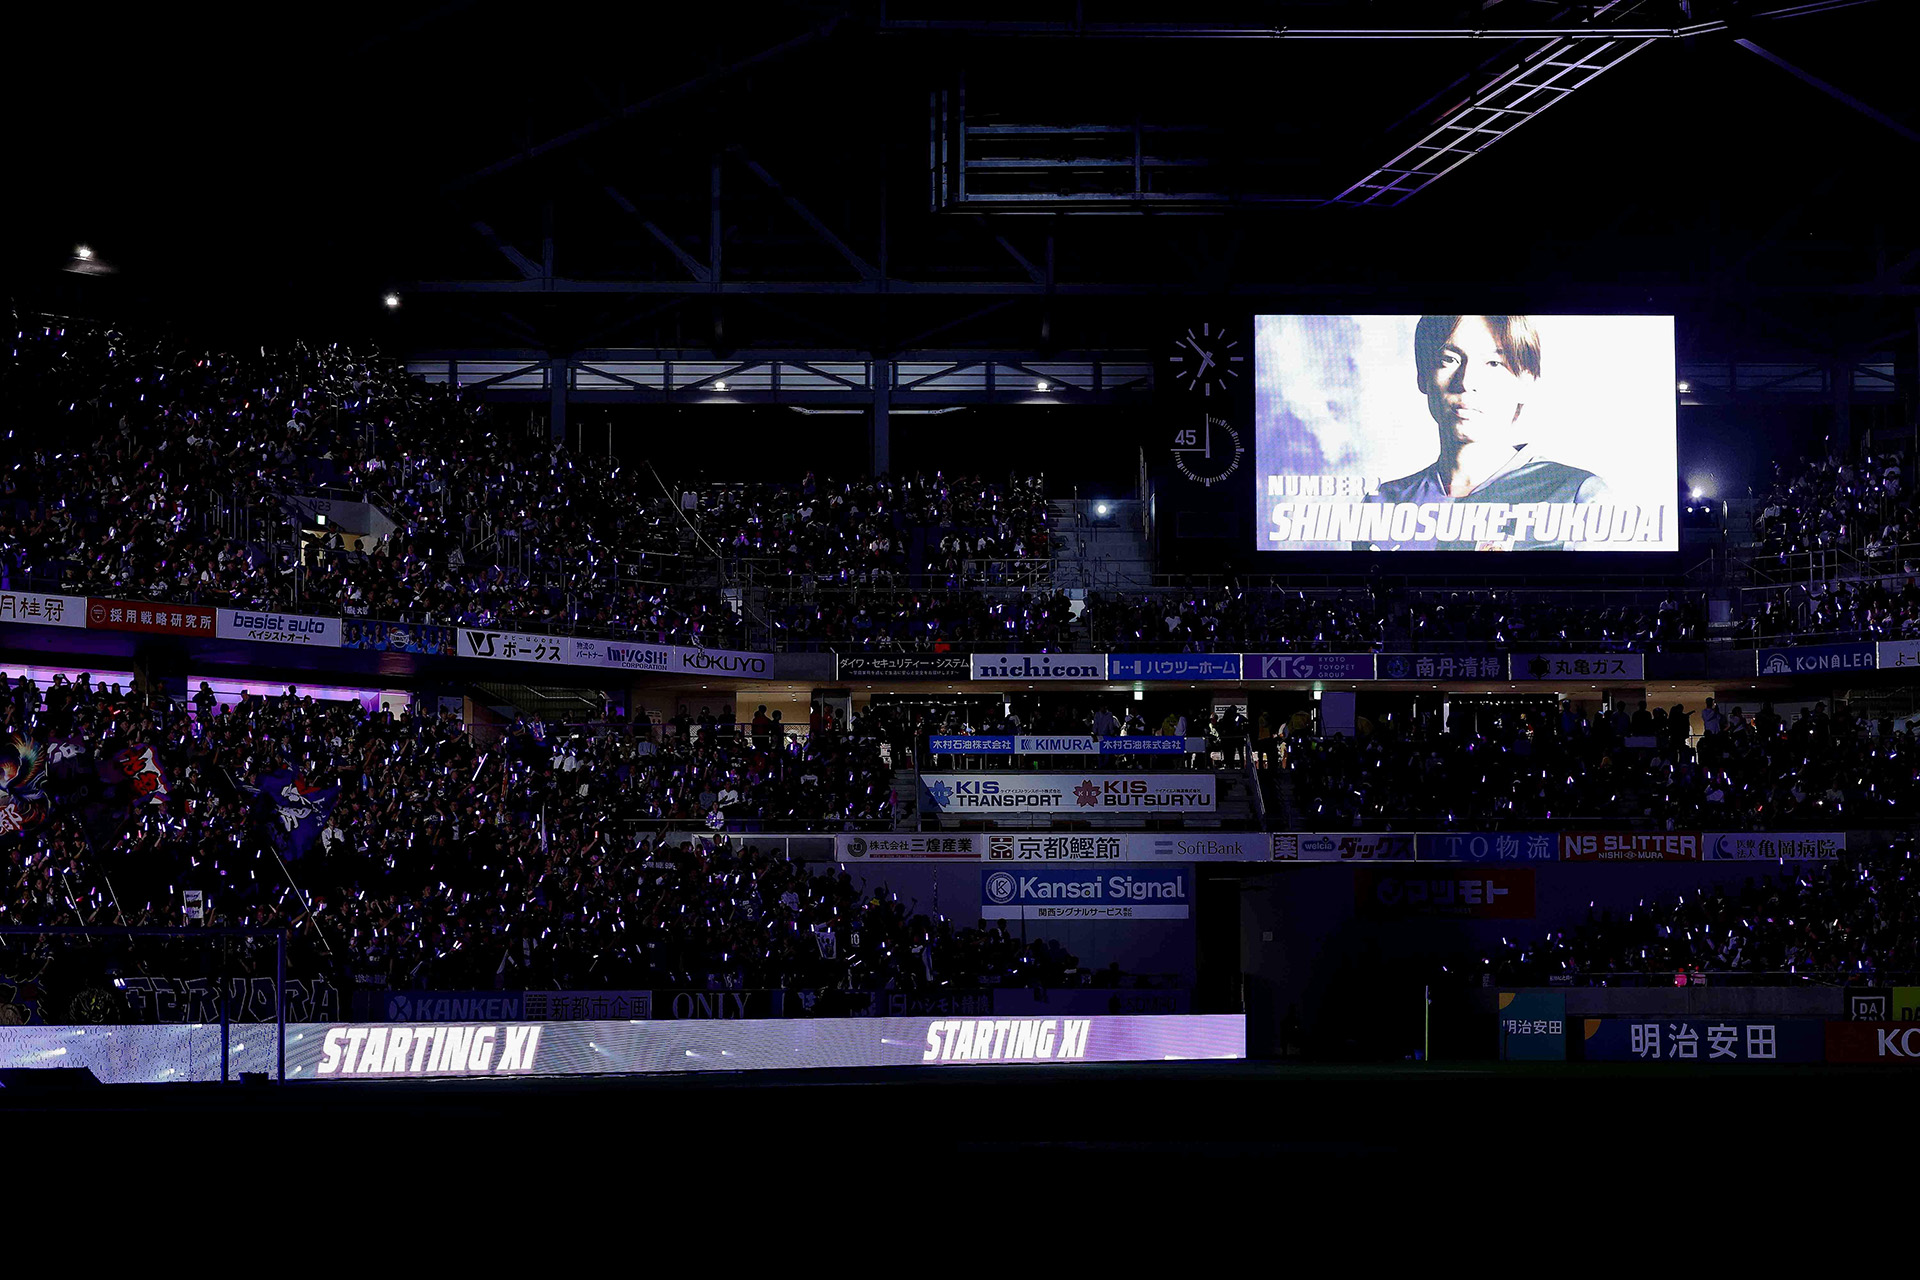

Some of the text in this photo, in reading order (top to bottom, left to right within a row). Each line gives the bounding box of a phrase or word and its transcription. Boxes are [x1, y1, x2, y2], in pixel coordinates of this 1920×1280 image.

[1174, 429, 1197, 446] 45
[1268, 475, 1365, 496] NUMBER
[309, 499, 331, 512] N23
[1269, 502, 1665, 542] SHINNOSUKE FUKUDA
[0, 594, 64, 622] 月桂冠
[109, 607, 212, 630] 採用戦略研究所
[233, 611, 325, 634] basist auto
[247, 629, 311, 642] ベイシストオート
[503, 642, 561, 662] ボークス
[576, 650, 604, 660] パートナー
[621, 661, 668, 671] CORPORATION
[683, 653, 765, 673] KOKUYO
[839, 657, 970, 669] ダイワ・セキュリティー・システム
[980, 657, 1099, 677] nichicon
[1146, 660, 1236, 675] ハウツーホーム
[1416, 657, 1501, 678] 南丹清掃
[1555, 659, 1626, 675] 丸亀ガス
[932, 739, 1012, 750] 木村石油株式会社
[1035, 739, 1093, 750] KIMURA
[1102, 739, 1182, 750] 木村石油株式会社
[956, 781, 1000, 794] KIS
[1104, 781, 1147, 793] KIS
[957, 795, 1062, 807] TRANSPORT
[1104, 794, 1210, 806] BUTSURYU
[1017, 837, 1121, 860] 京都鰹節
[1178, 840, 1244, 854] SoftBank
[1338, 837, 1411, 859] ダックス
[1565, 835, 1697, 858] NS SLITTER
[1598, 851, 1664, 859] NISHI MURA
[1758, 839, 1838, 857] 亀岡病院
[1020, 876, 1185, 900] Kansai Signal
[416, 998, 519, 1021] KANKEN
[551, 995, 648, 1020] 新都市企画
[672, 992, 752, 1019] ONLY
[1502, 1019, 1563, 1035] 明治安田
[923, 1019, 1091, 1061] STARTING XI
[1630, 1023, 1777, 1059] 明治安田
[318, 1026, 542, 1074] STARTING XI
